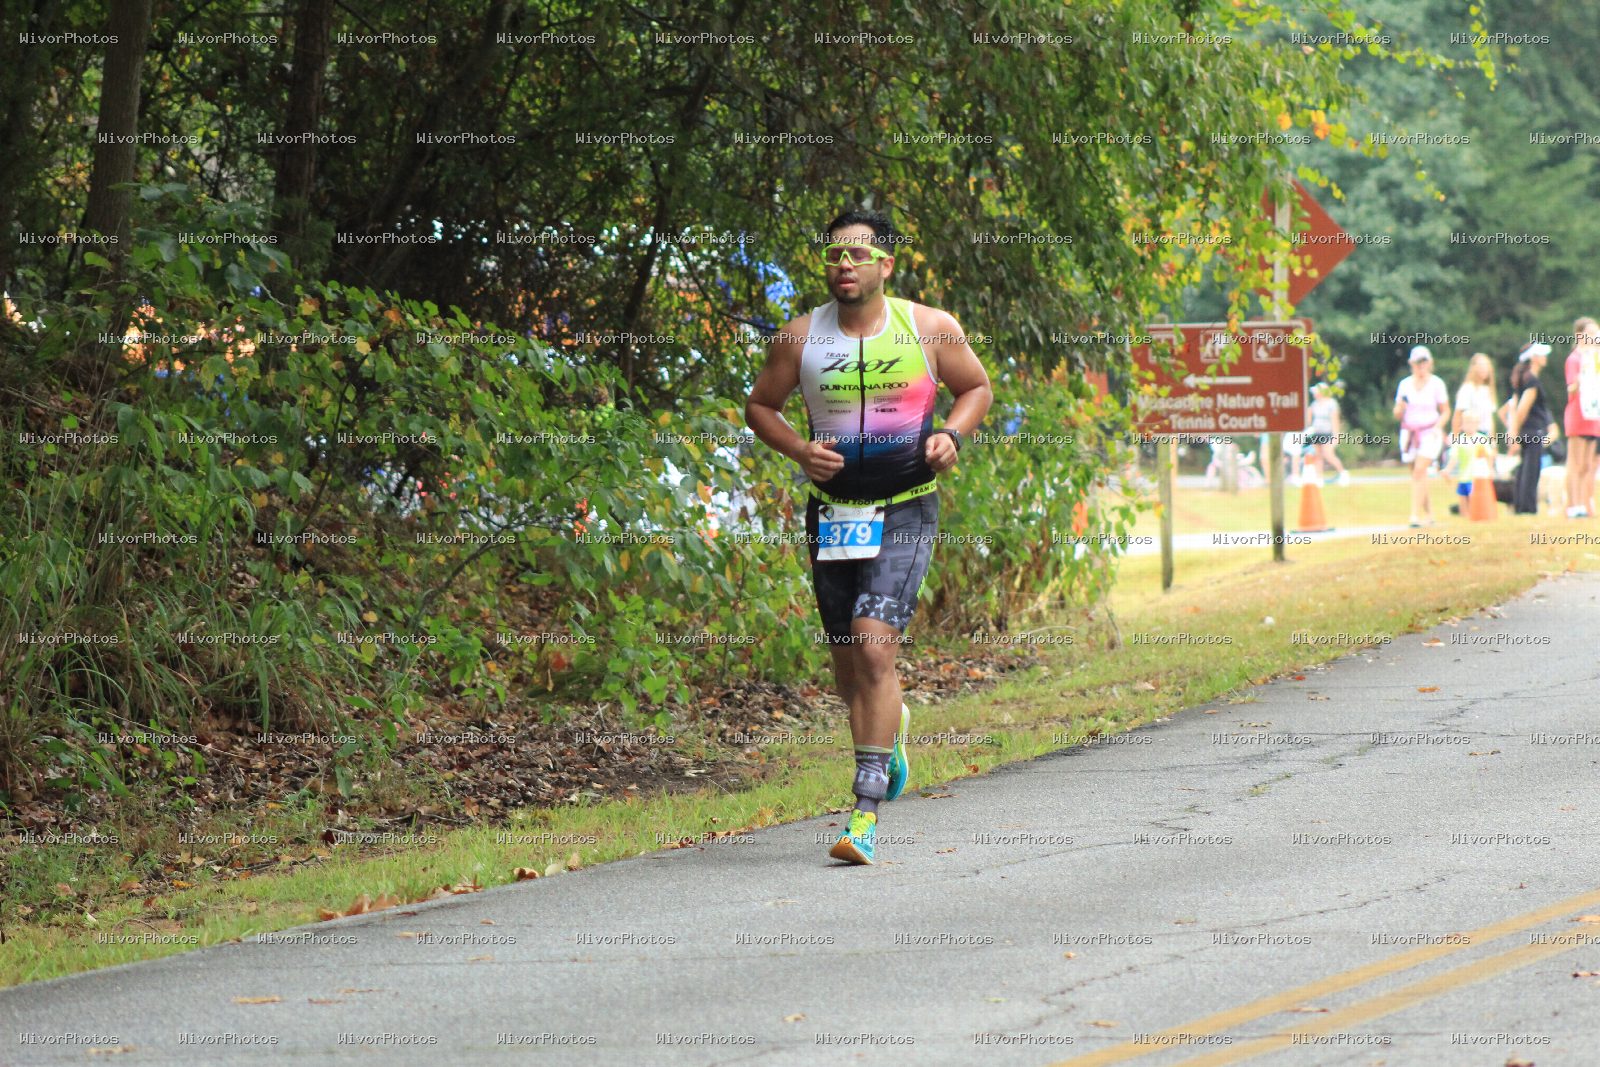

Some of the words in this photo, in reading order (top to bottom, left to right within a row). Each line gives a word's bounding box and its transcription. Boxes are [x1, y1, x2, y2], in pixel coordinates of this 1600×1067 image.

[1216, 392, 1264, 408] Nature
[1267, 391, 1299, 407] Trail
[1169, 412, 1214, 429] Tennis
[1218, 413, 1267, 429] Courts
[909, 485, 930, 496] TEAM
[830, 522, 872, 545] 379
